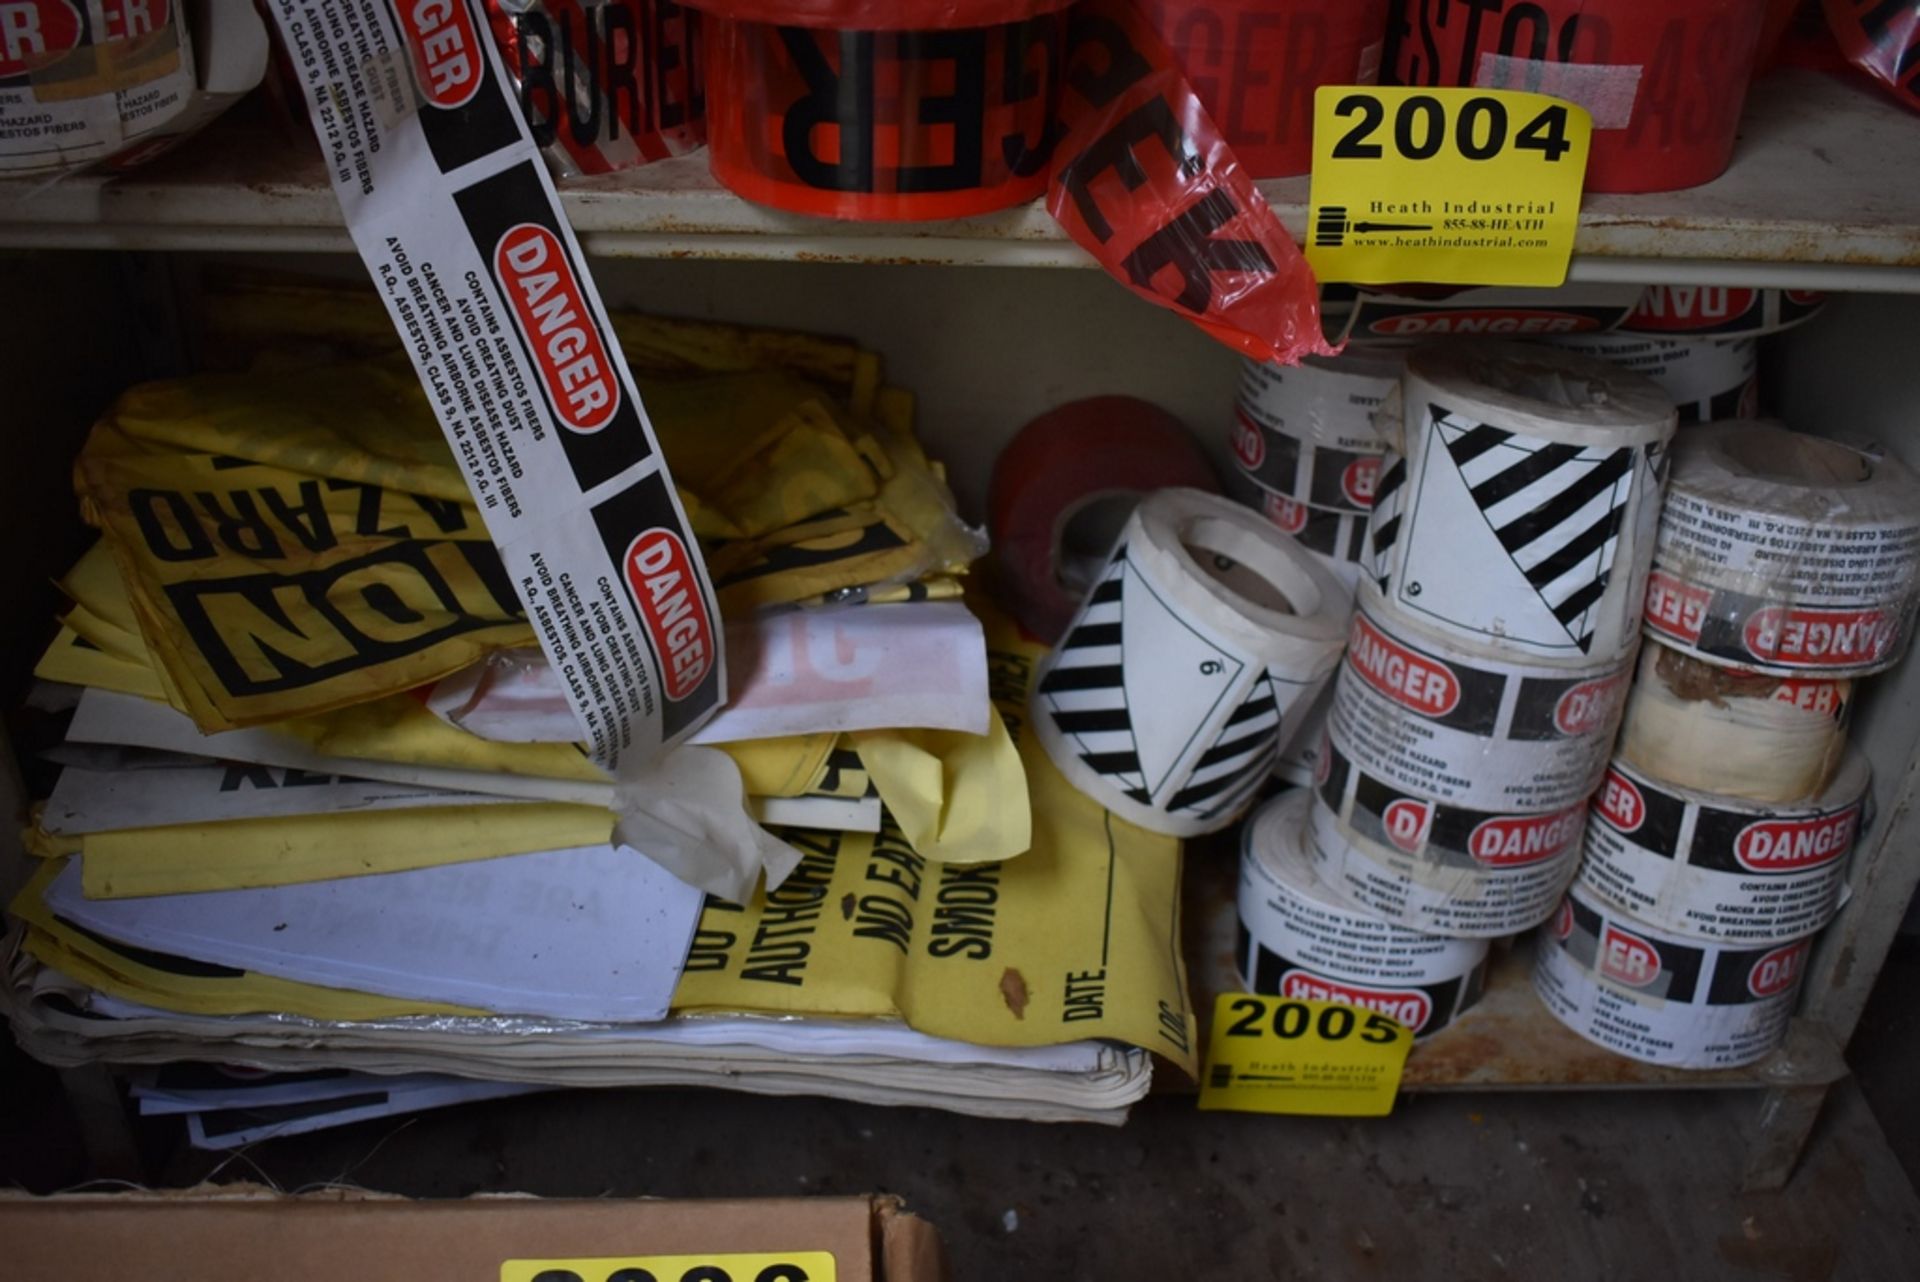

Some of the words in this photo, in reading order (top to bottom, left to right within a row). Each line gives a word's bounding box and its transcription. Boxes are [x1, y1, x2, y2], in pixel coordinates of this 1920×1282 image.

[0, 2, 46, 61] R
[288, 20, 316, 69] CLASS
[305, 68, 320, 86] 9,
[312, 84, 327, 106] NA
[320, 0, 344, 40] LUNG
[336, 40, 366, 100] DISEASE
[358, 99, 381, 155] HAZARD
[302, 6, 340, 79] AIRBORNE
[330, 79, 361, 150] ASBESTOS
[352, 149, 374, 196] FIBERS
[318, 105, 339, 141] 2212
[44, 121, 86, 135] FIBERS
[1331, 94, 1570, 161] 2004
[1370, 201, 1432, 213] Heath
[1443, 201, 1555, 214] Industrial
[1443, 219, 1545, 231] 855-88-HEATH
[1353, 236, 1548, 248] www.heathindustrial.com
[376, 262, 401, 296] R.Q.,
[391, 294, 434, 367] ASBESTOS,
[506, 234, 610, 421] DANGER
[1395, 317, 1581, 335] DANGER
[384, 233, 414, 278] AVOID
[405, 276, 448, 352] BREATHING
[439, 350, 476, 414] AIRBORNE
[467, 413, 503, 476] ASBESTOS
[494, 475, 523, 519] FIBERS
[418, 260, 452, 316] CANCER
[443, 314, 464, 344] AND
[456, 343, 480, 380] LUNG
[471, 379, 503, 431] DISEASE
[494, 430, 524, 480] HAZARD
[454, 295, 482, 338] AVOID
[472, 336, 509, 400] CREATING
[500, 399, 523, 434] DUST
[462, 269, 500, 336] CONTAINS
[491, 334, 528, 399] ASBESTOS
[518, 398, 546, 442] FIBERS
[425, 364, 452, 407] CLASS
[441, 405, 458, 421] 9,
[449, 419, 467, 440] NA
[458, 438, 480, 469] 2212
[528, 550, 553, 588] AVOID
[545, 586, 581, 650] BREATHING
[574, 650, 606, 705] AIRBORNE
[532, 602, 569, 666] ASBESTOS,
[634, 538, 705, 692] DANGER
[1646, 589, 1710, 635] GER
[557, 571, 585, 619] CANCER
[577, 617, 596, 643] AND
[589, 642, 609, 674] LUNG
[602, 672, 627, 716] DISEASE
[588, 599, 611, 636] AVOID
[604, 634, 633, 689] CREATING
[626, 687, 641, 714] DUST
[595, 575, 627, 632] CONTAINS
[619, 631, 648, 685] ASBESTOS
[639, 683, 654, 717] FIBERS
[562, 663, 585, 699] CLASS
[576, 698, 591, 713] 9,
[582, 711, 598, 729] NA
[1604, 784, 1637, 826] ER
[852, 895, 914, 955] NO
[1608, 943, 1649, 983] ER
[1063, 968, 1106, 1023] DATE
[1226, 999, 1399, 1043] 2005
